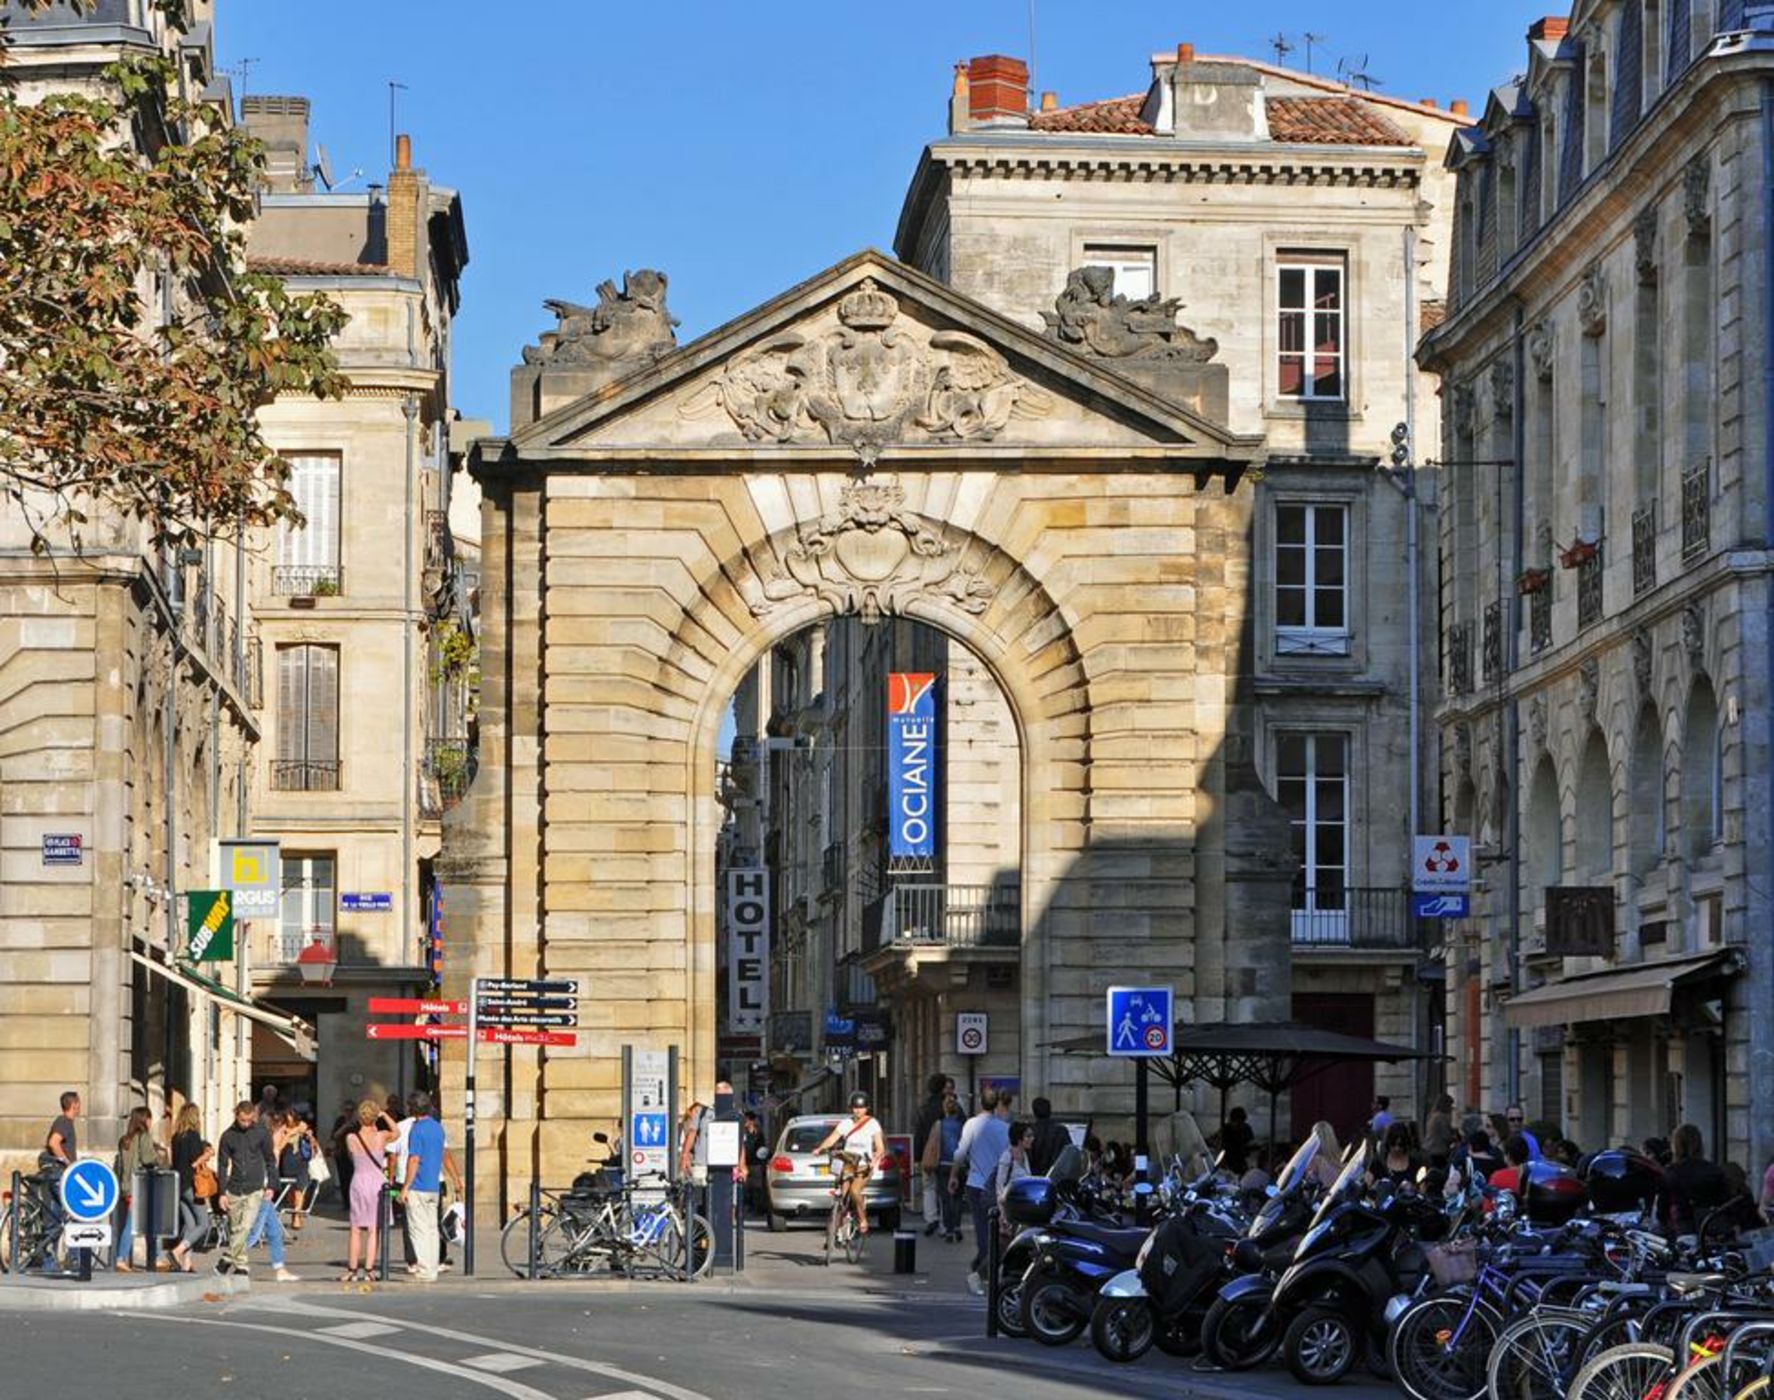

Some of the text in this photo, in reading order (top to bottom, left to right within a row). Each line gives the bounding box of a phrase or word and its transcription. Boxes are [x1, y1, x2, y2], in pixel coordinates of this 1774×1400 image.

[902, 724, 928, 844] OCIANE
[233, 890, 276, 906] RGUS
[189, 890, 231, 960] SUBWAY
[734, 874, 764, 1010] HOTEL
[420, 1002, 450, 1013] Hôtels
[495, 1032, 524, 1042] Hôtels
[1149, 1033, 1161, 1043] 20
